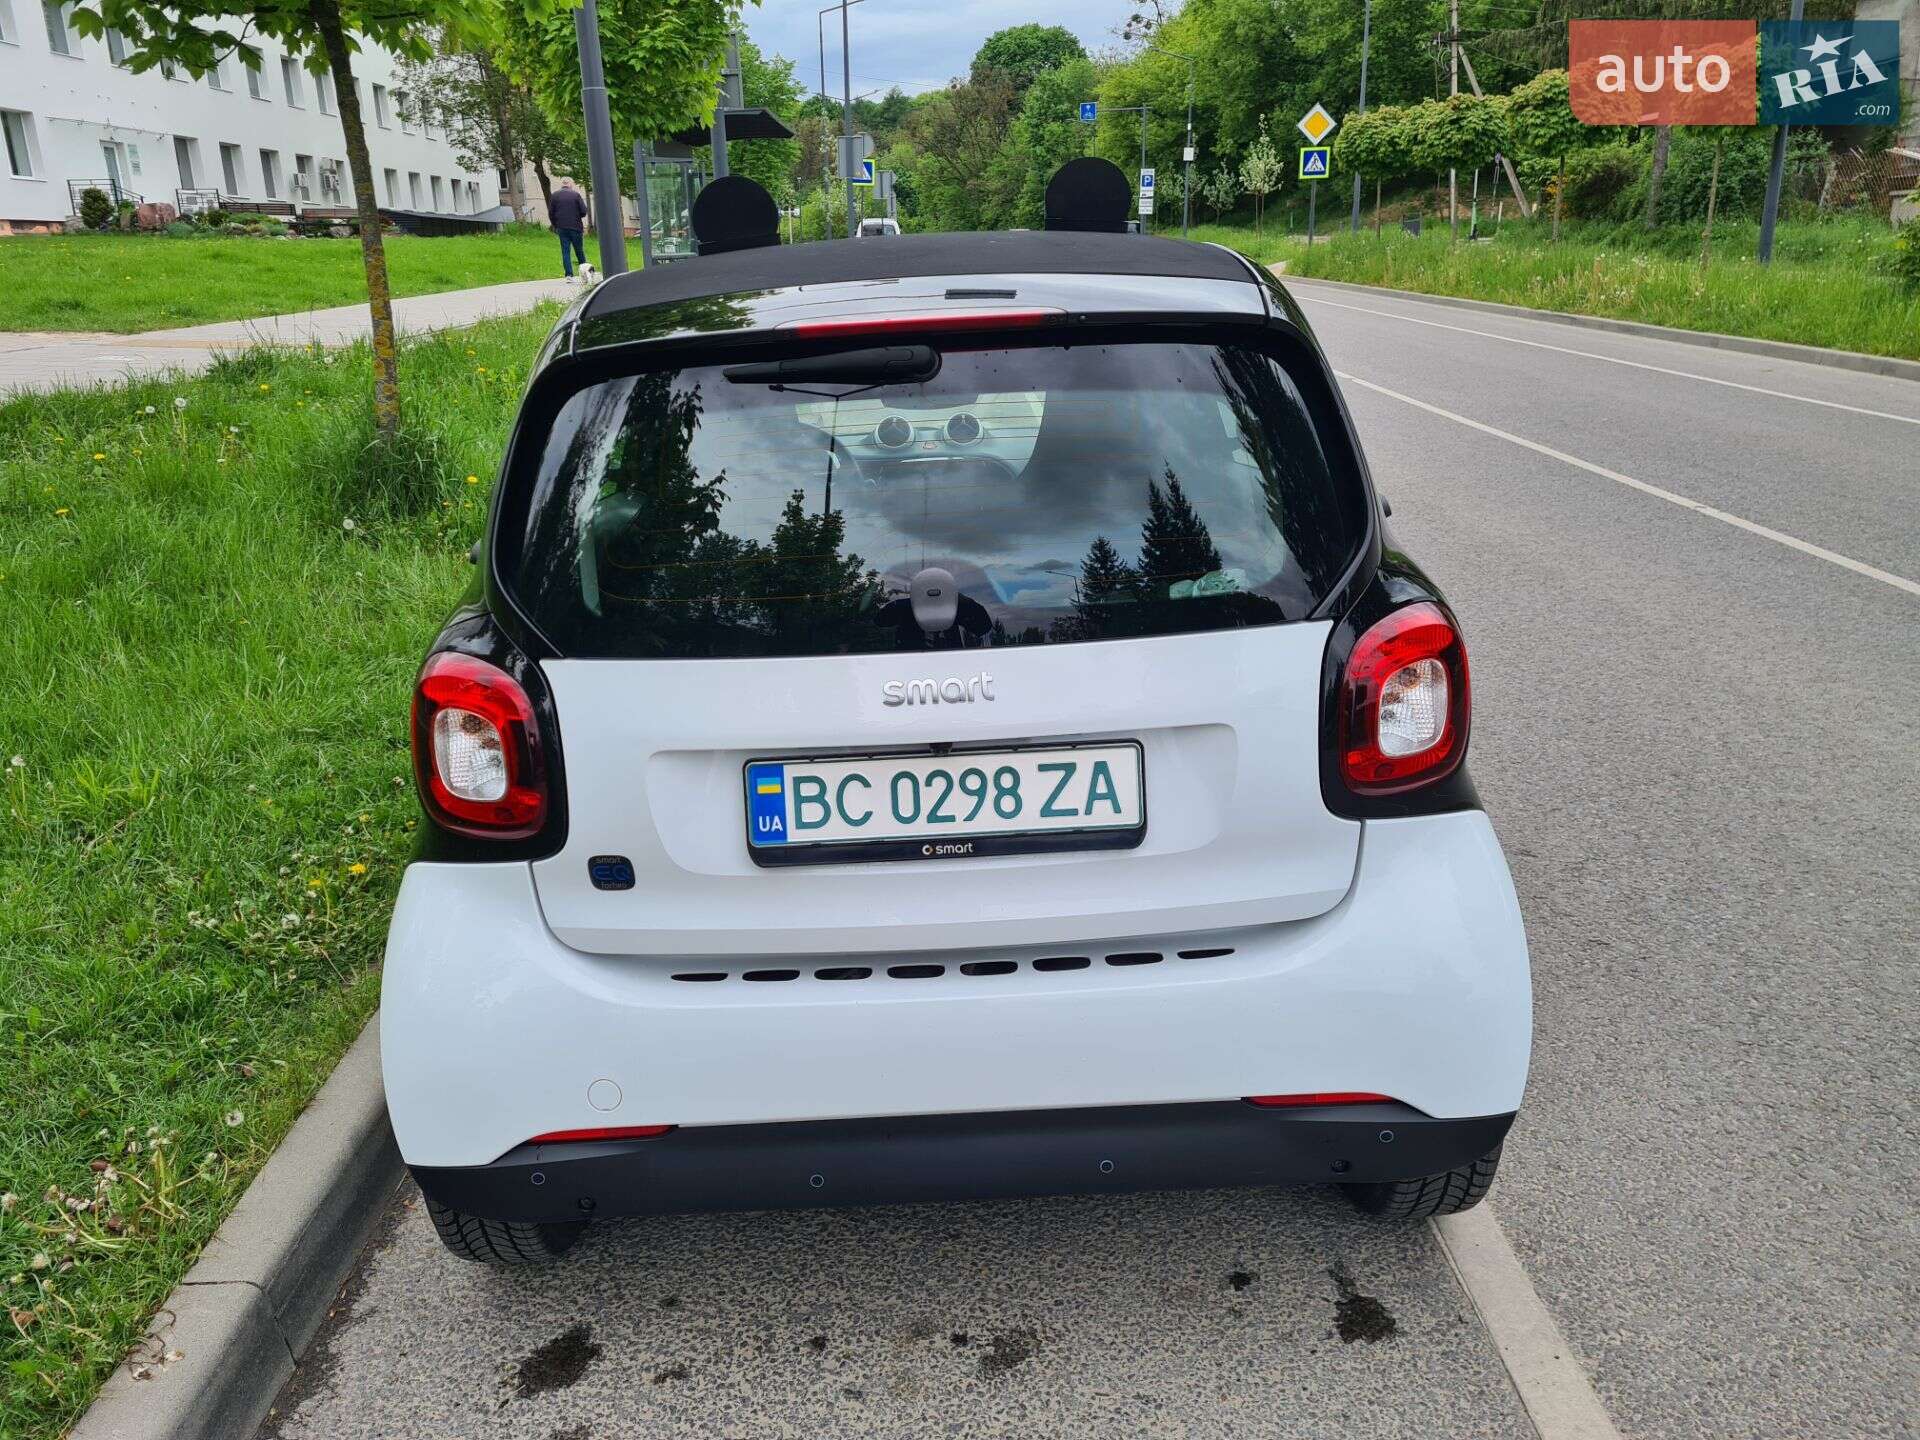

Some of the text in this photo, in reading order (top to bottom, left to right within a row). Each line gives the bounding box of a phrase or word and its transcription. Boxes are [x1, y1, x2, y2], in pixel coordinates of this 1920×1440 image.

[882, 671, 995, 707] smart
[792, 761, 1122, 830] BC 0298 ZA
[758, 815, 783, 832] UA
[935, 842, 973, 855] smart
